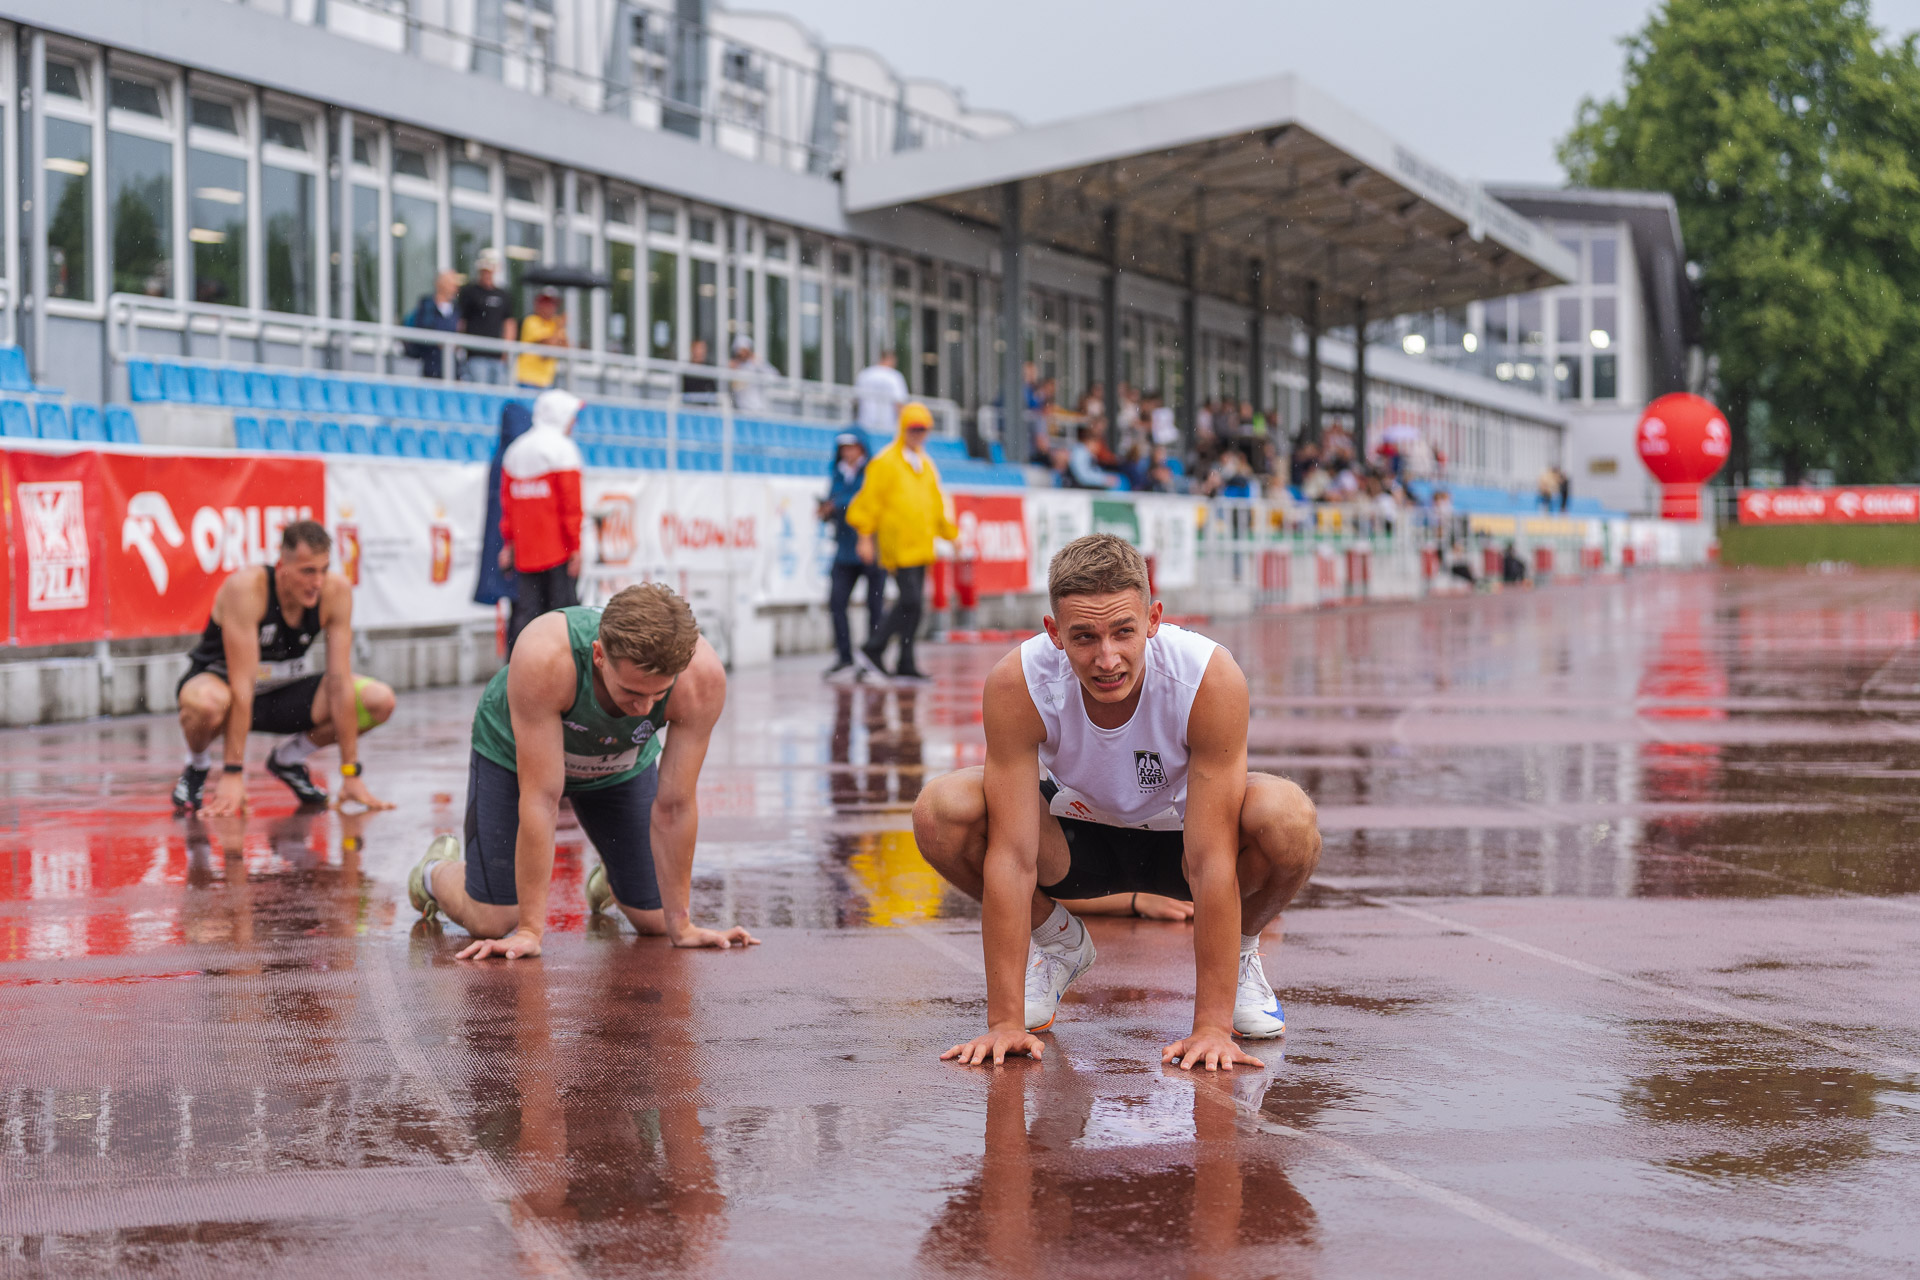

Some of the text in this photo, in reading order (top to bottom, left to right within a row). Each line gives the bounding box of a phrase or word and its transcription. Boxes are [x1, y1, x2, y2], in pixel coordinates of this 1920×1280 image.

[32, 564, 86, 600] PZLA
[1139, 768, 1162, 777] AZS
[1140, 776, 1163, 785] AWF
